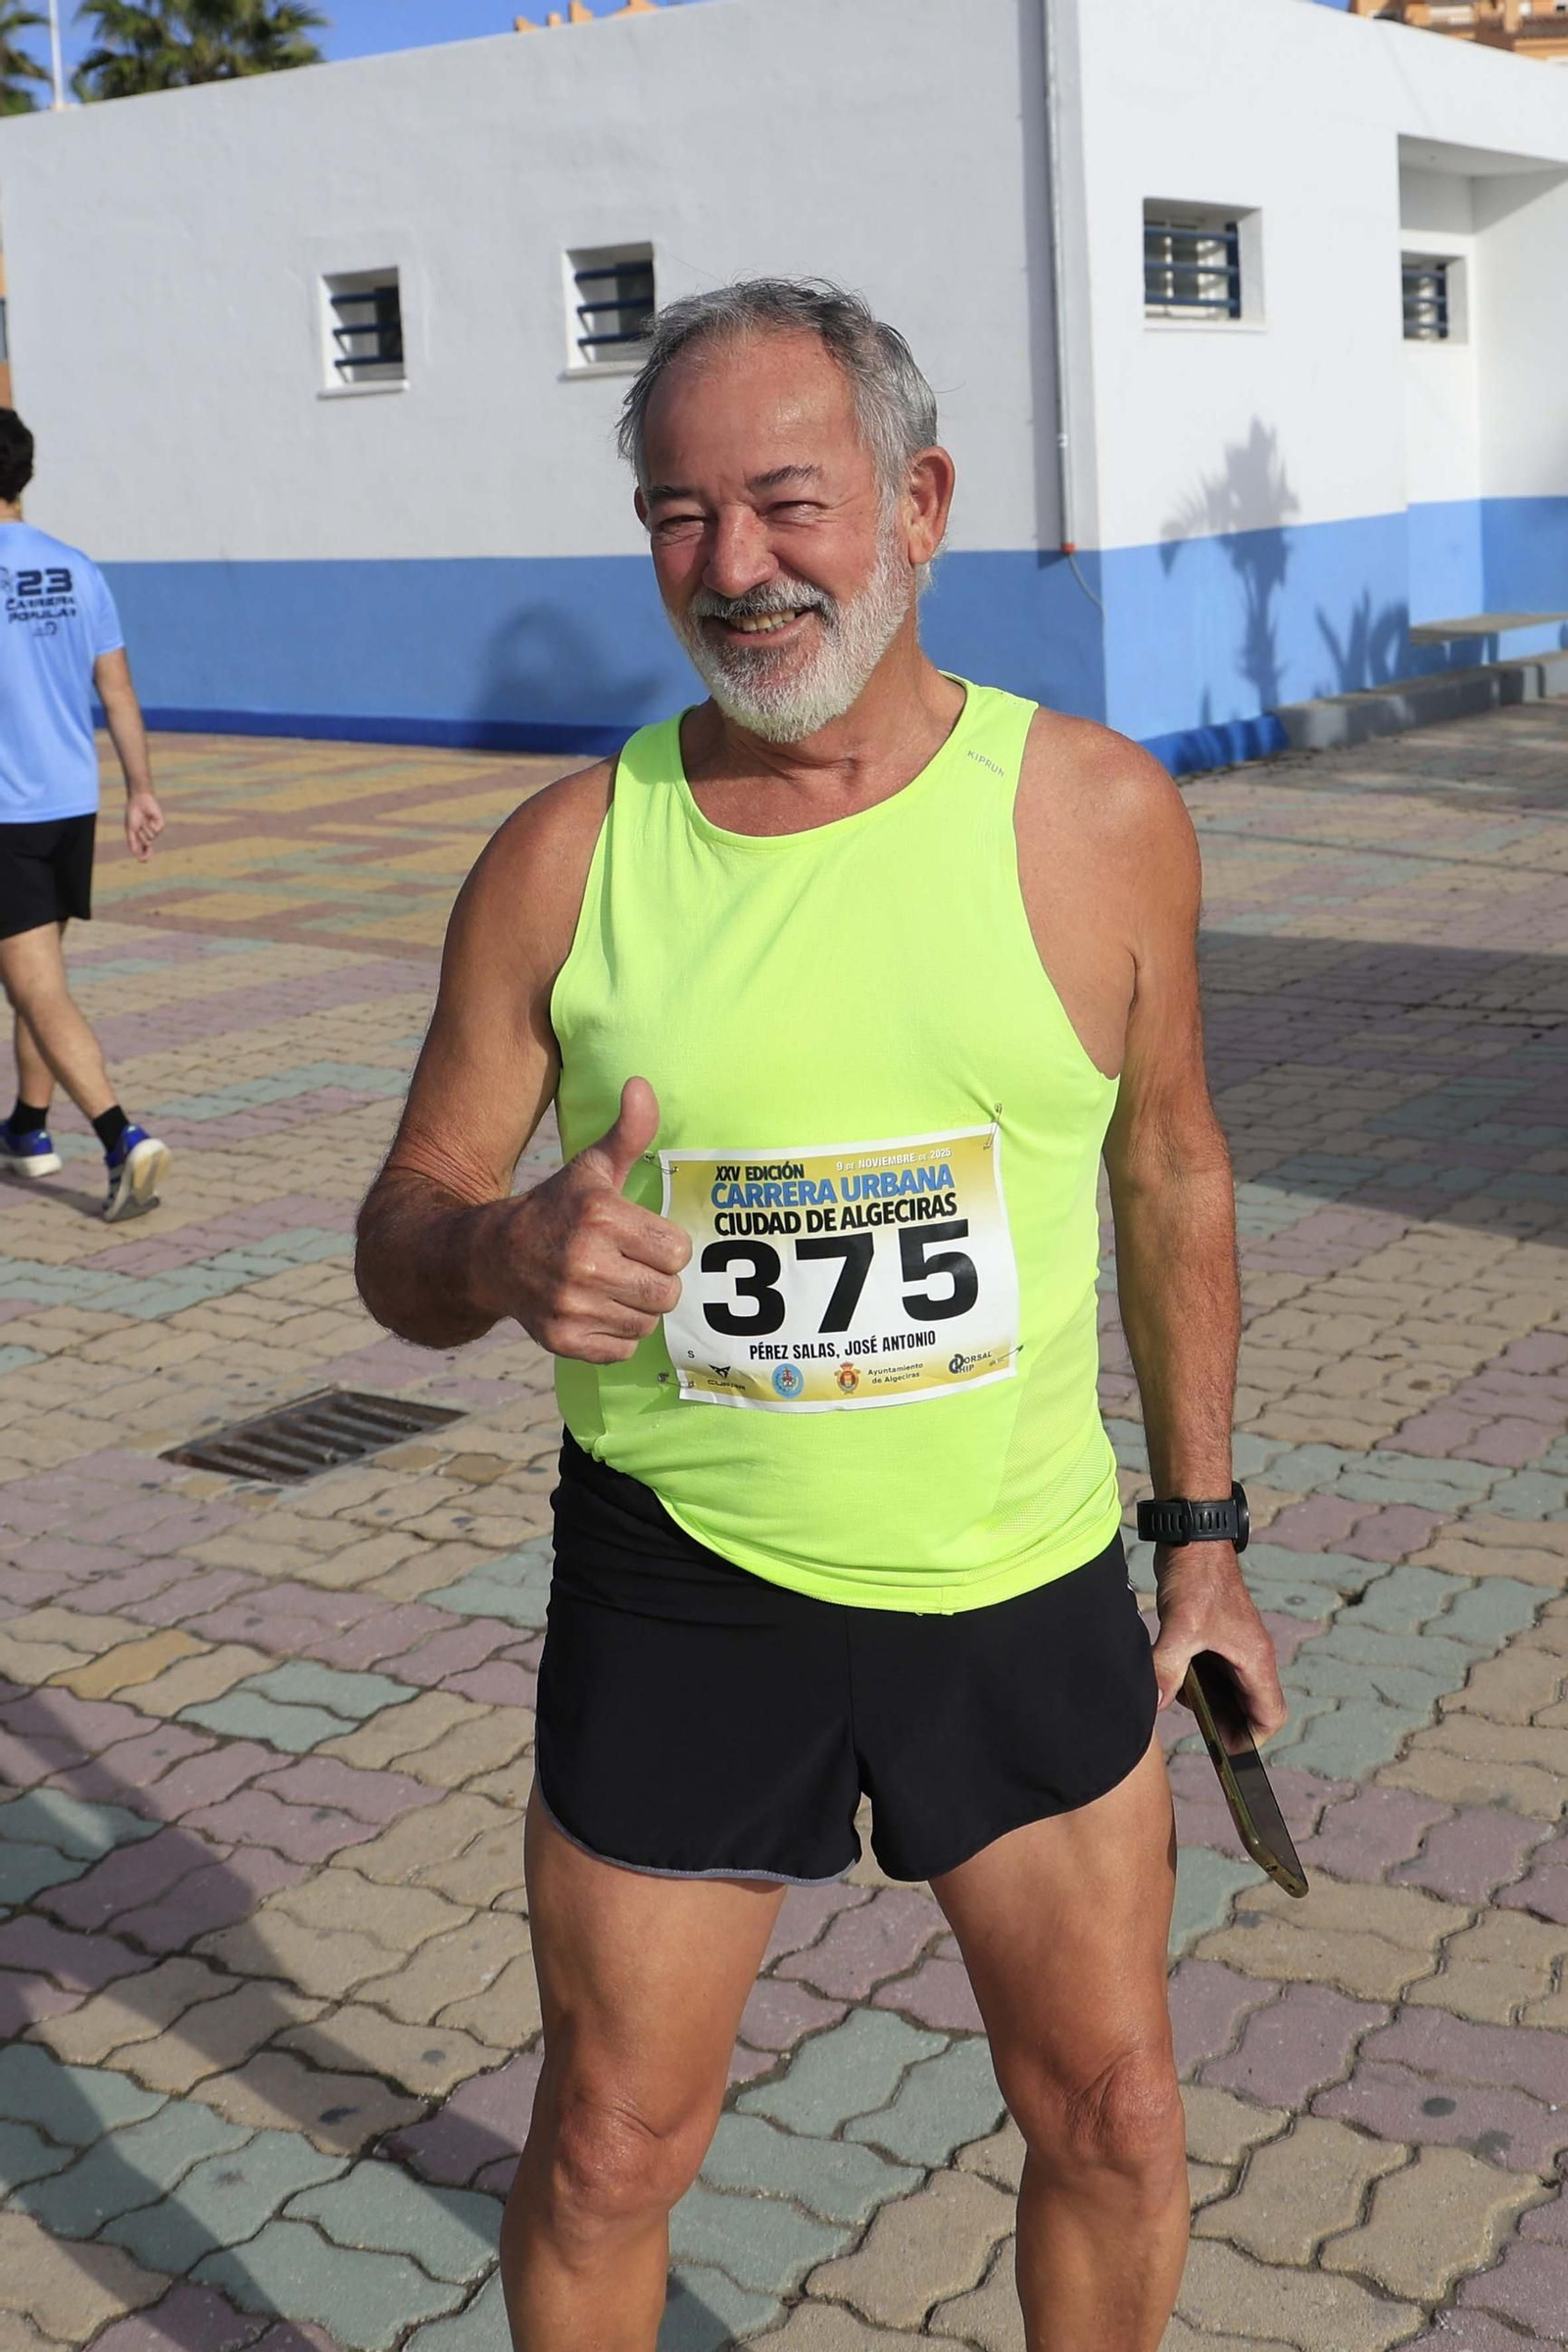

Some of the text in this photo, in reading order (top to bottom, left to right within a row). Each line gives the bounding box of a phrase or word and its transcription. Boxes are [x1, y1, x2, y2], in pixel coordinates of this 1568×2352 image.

[17, 568, 73, 597] 23
[966, 749, 1005, 778] KIPRUN
[714, 1161, 805, 1182] XXV EDICIÓN
[836, 1161, 844, 1172] 9
[858, 1152, 915, 1169] NOVIEMBRE
[930, 1148, 953, 1160] 2025
[710, 1163, 955, 1209] CARRERA URBANA
[714, 1192, 957, 1237] CIUDAD DE ALGECIRAS
[700, 1218, 979, 1337] 375
[687, 1349, 696, 1359] S
[750, 1330, 936, 1360] PÉREZ SALAS, JOSÉ ANTONIO
[867, 1362, 924, 1377] Ayuntamiento
[884, 1374, 920, 1386] Algeciras
